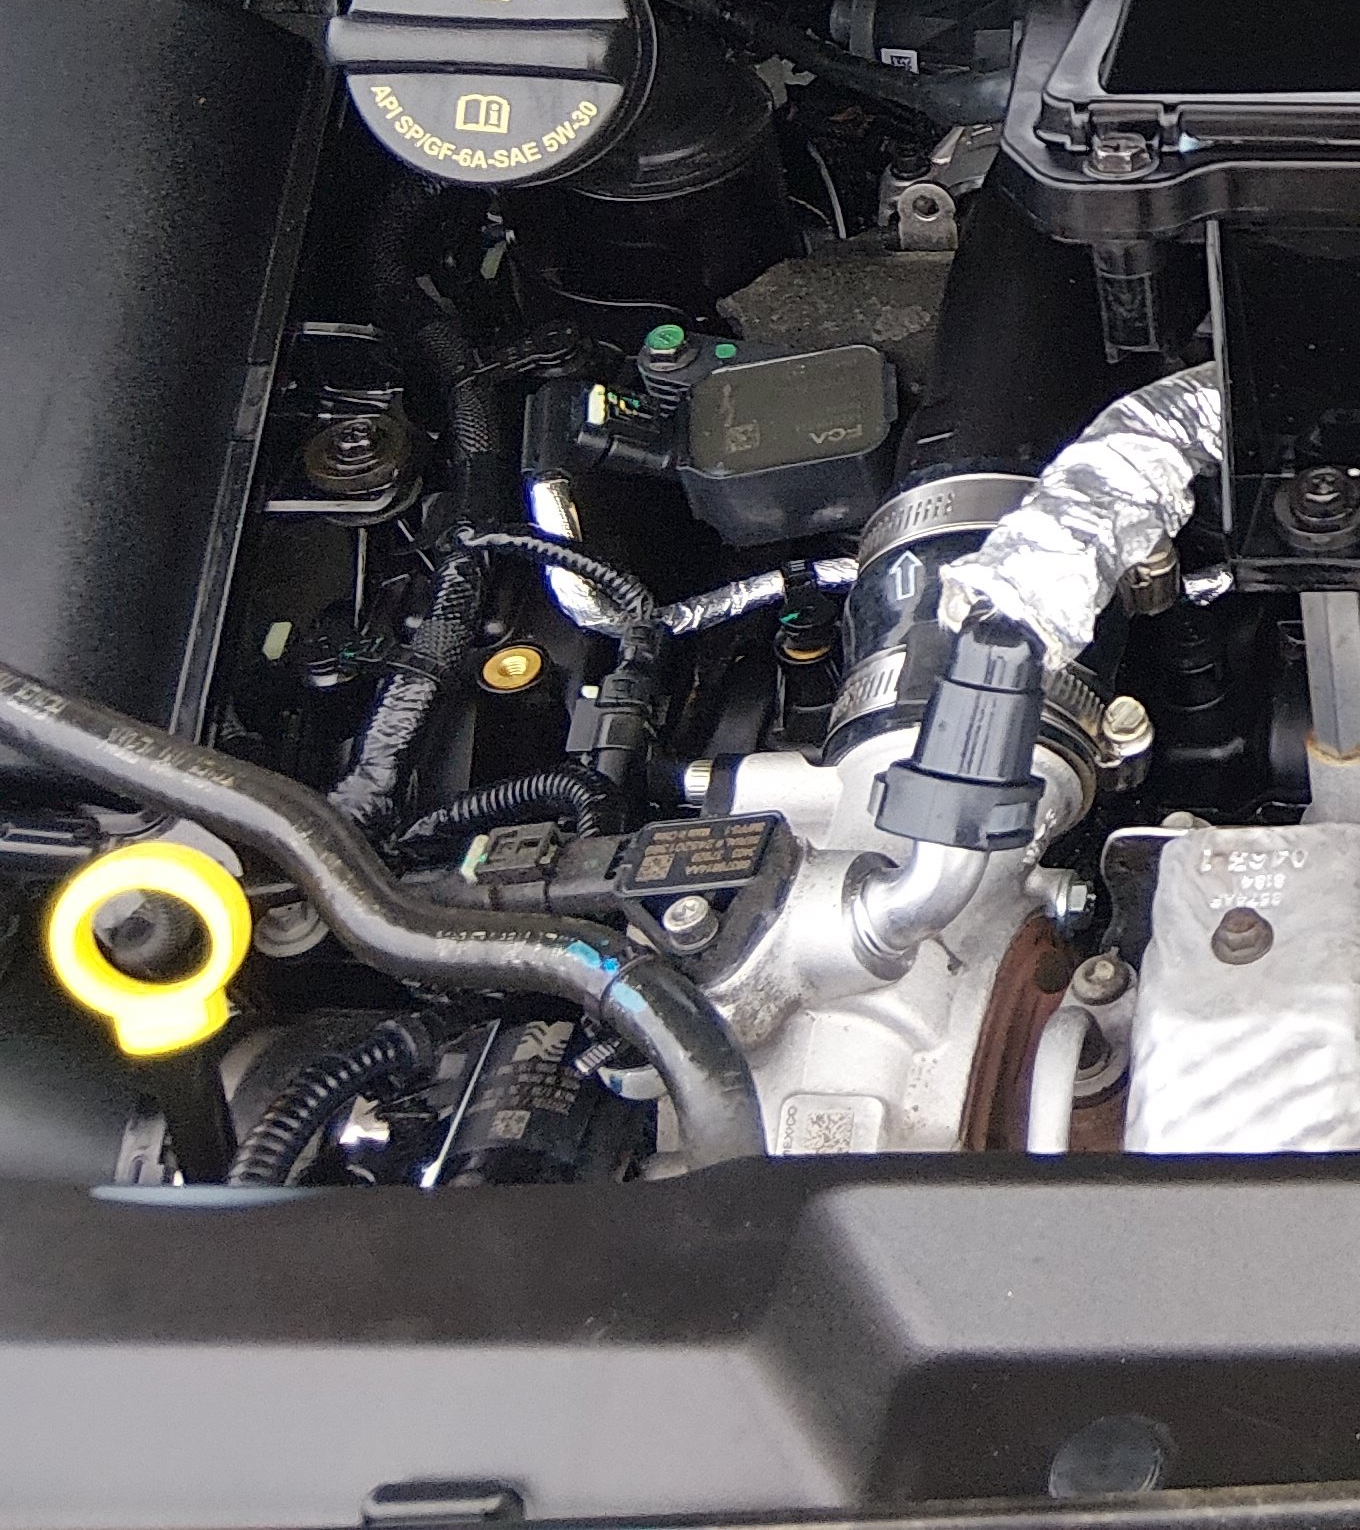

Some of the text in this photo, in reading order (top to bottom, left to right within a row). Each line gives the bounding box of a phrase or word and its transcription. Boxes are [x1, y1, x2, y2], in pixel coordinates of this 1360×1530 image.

[370, 83, 404, 120] API
[543, 100, 599, 153] 5W-30
[808, 423, 864, 446] FCA
